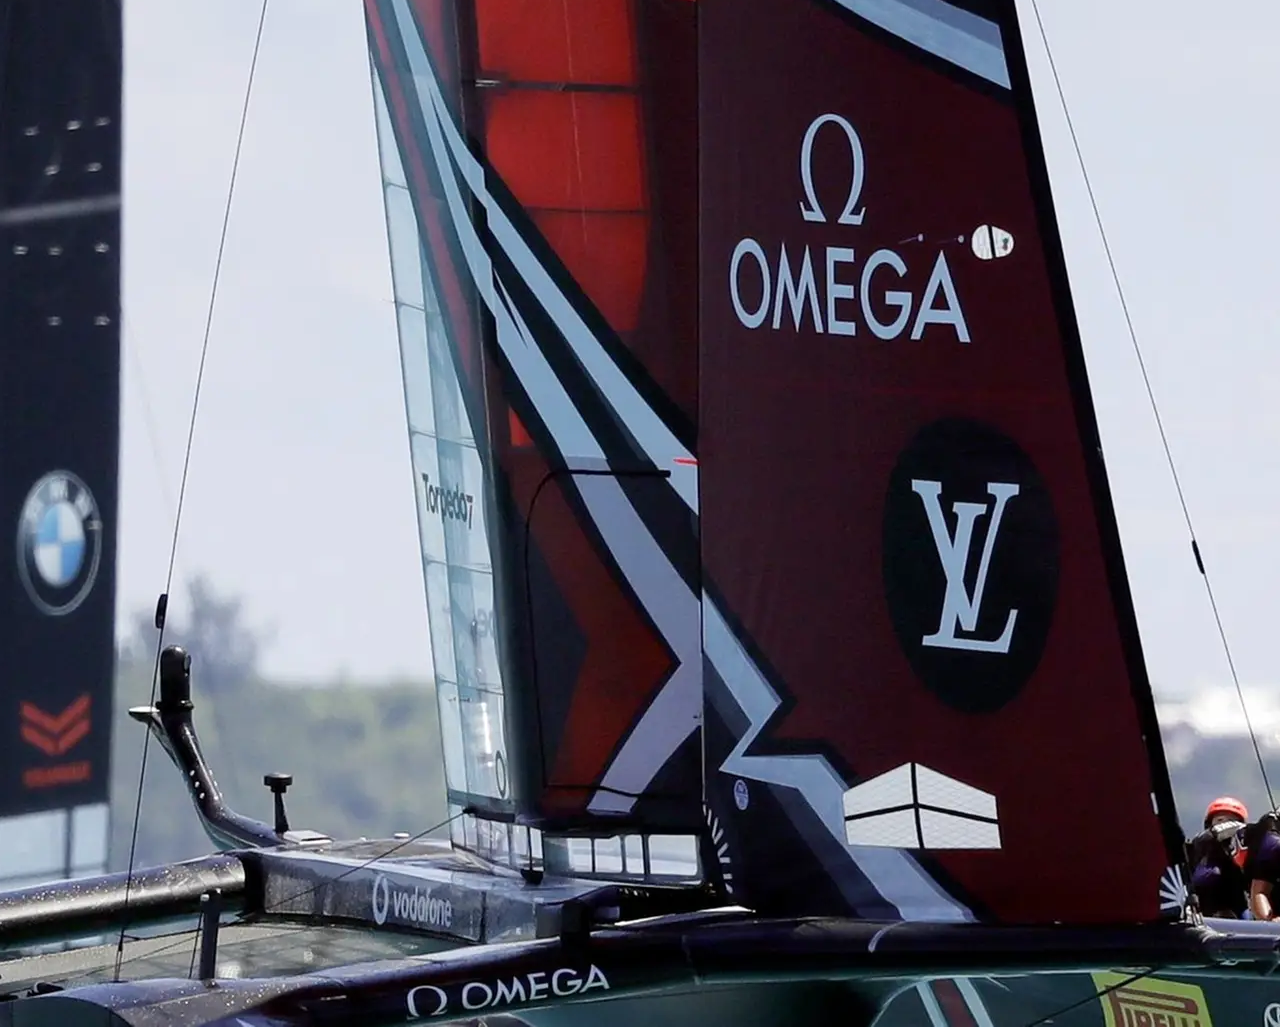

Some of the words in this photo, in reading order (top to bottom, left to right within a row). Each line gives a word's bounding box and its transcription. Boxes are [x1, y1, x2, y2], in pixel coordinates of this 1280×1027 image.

[729, 237, 971, 344] OMEGA
[422, 472, 473, 530] Torpedo7
[393, 885, 452, 928] vodafone
[461, 963, 610, 1010] OMEGA
